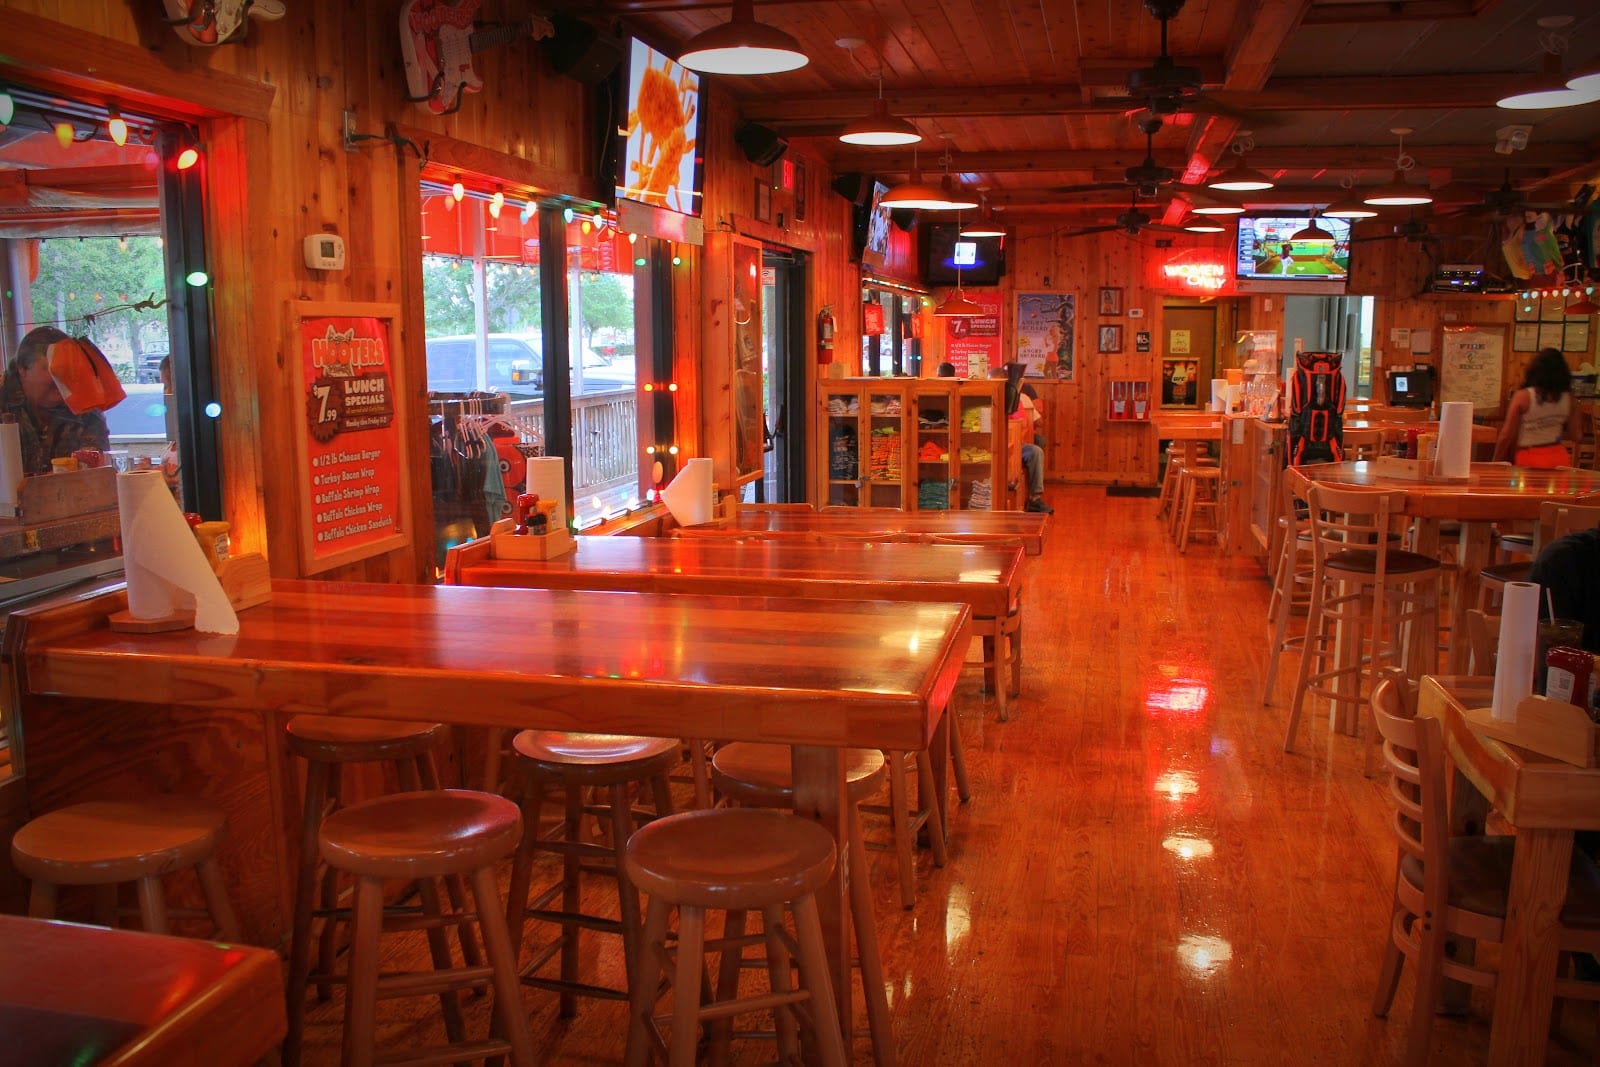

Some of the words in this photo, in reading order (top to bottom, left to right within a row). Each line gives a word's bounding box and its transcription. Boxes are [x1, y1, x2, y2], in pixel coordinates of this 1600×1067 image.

[1163, 265, 1224, 277] WOMEN
[1187, 275, 1227, 288] ONLY
[312, 338, 385, 368] HOOTERS
[344, 379, 385, 394] LUNCH
[345, 395, 385, 407] SPECIALS
[320, 455, 331, 466] 1/2
[331, 453, 338, 464] lb
[339, 451, 361, 463] Cheese
[362, 449, 381, 461] Burger
[321, 473, 341, 485] Turkey
[342, 471, 360, 481] Bacon
[361, 467, 375, 479] Wrap
[322, 489, 342, 503] Buffalo
[343, 487, 364, 499] Shrimp
[364, 484, 380, 496] Wrap
[323, 509, 343, 522] Buffalo
[344, 504, 366, 517] Chicken
[367, 501, 383, 513] Wrap
[323, 527, 344, 541] Buffalo
[346, 522, 367, 535] Chicken
[368, 514, 393, 530] Sandwich
